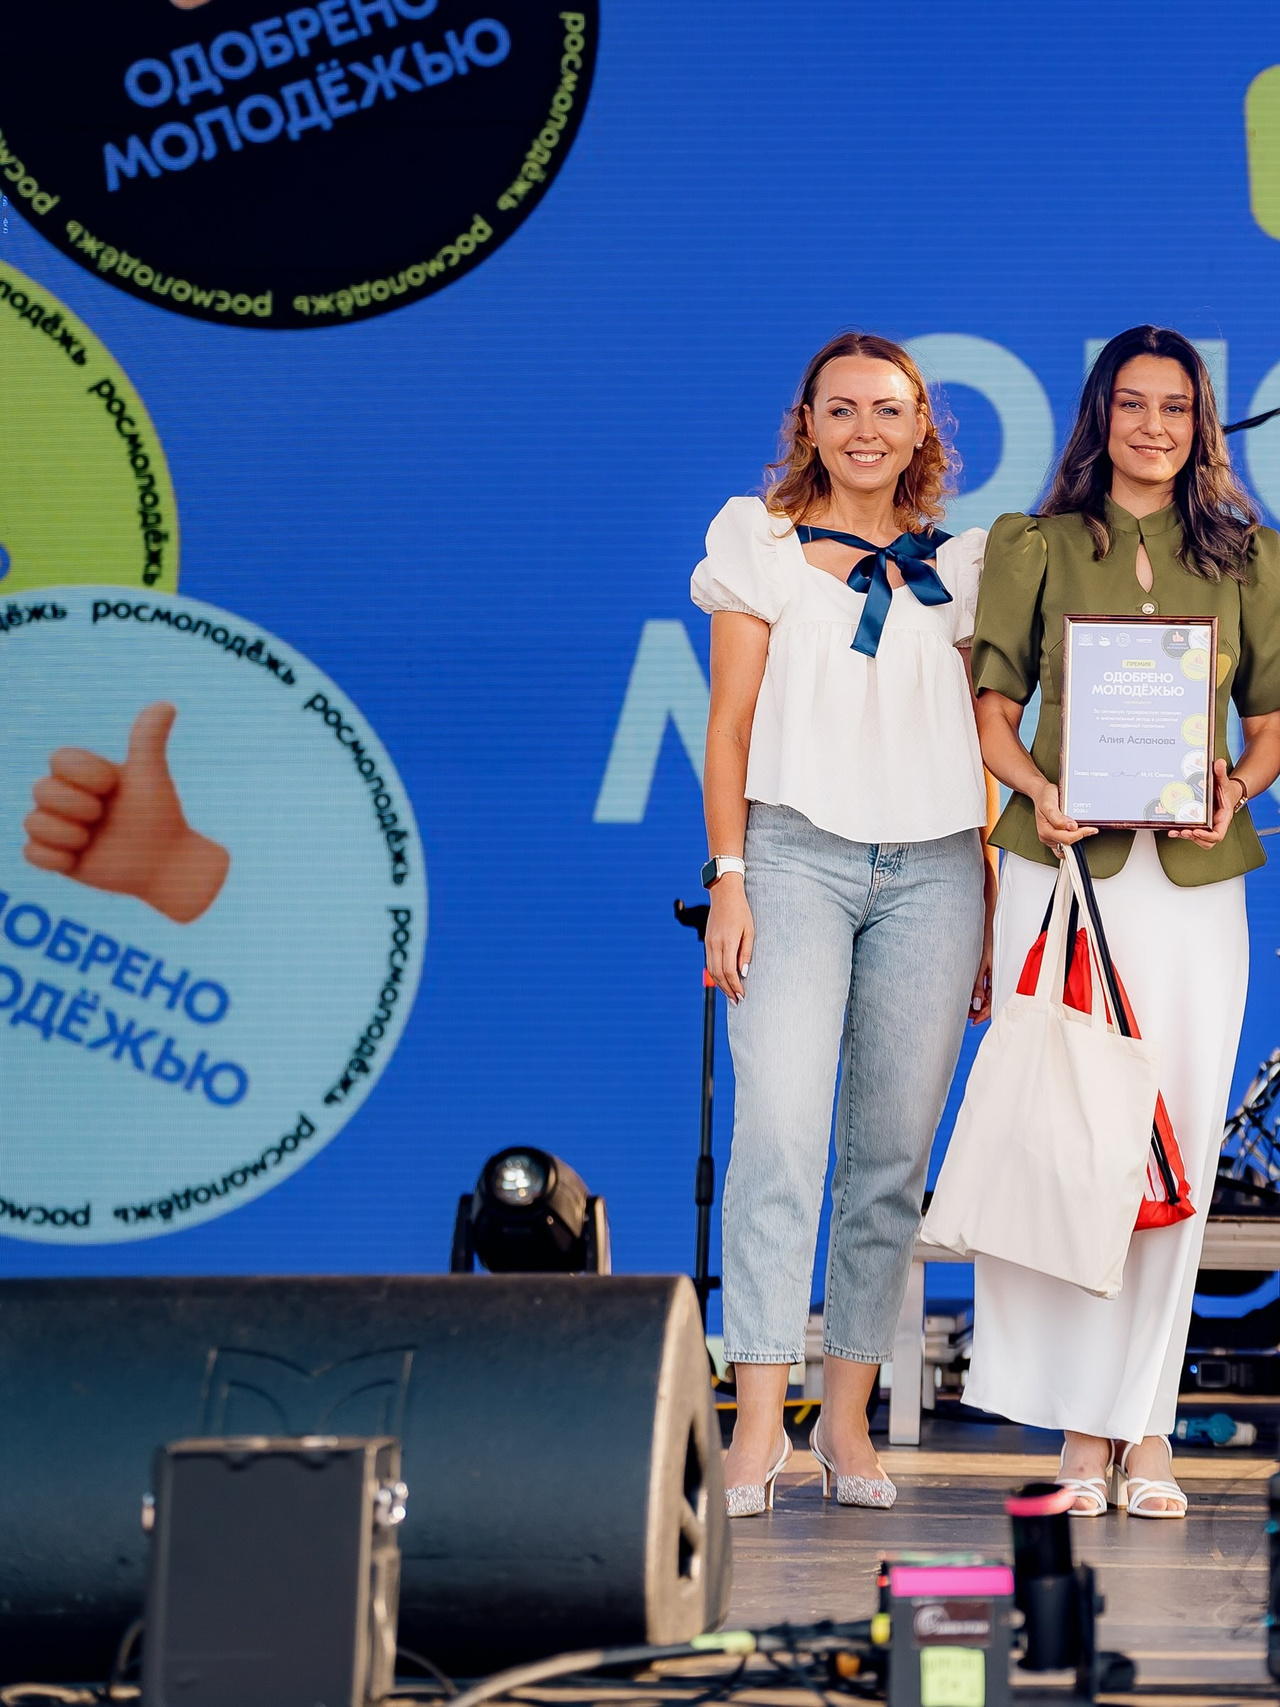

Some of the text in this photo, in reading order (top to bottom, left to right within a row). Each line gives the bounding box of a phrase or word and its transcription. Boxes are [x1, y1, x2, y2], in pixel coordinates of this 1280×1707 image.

[103, 18, 511, 192] МОЛОДЁЖЬЮ
[1091, 684, 1185, 697] МОЛОДЁЖЬЮ
[1103, 671, 1174, 684] ОДОБРЕНО
[1098, 734, 1176, 745] Алия Асланова
[0, 892, 231, 1025] ОБРЕНО
[0, 964, 249, 1108] ОДЁЖЬЮ
